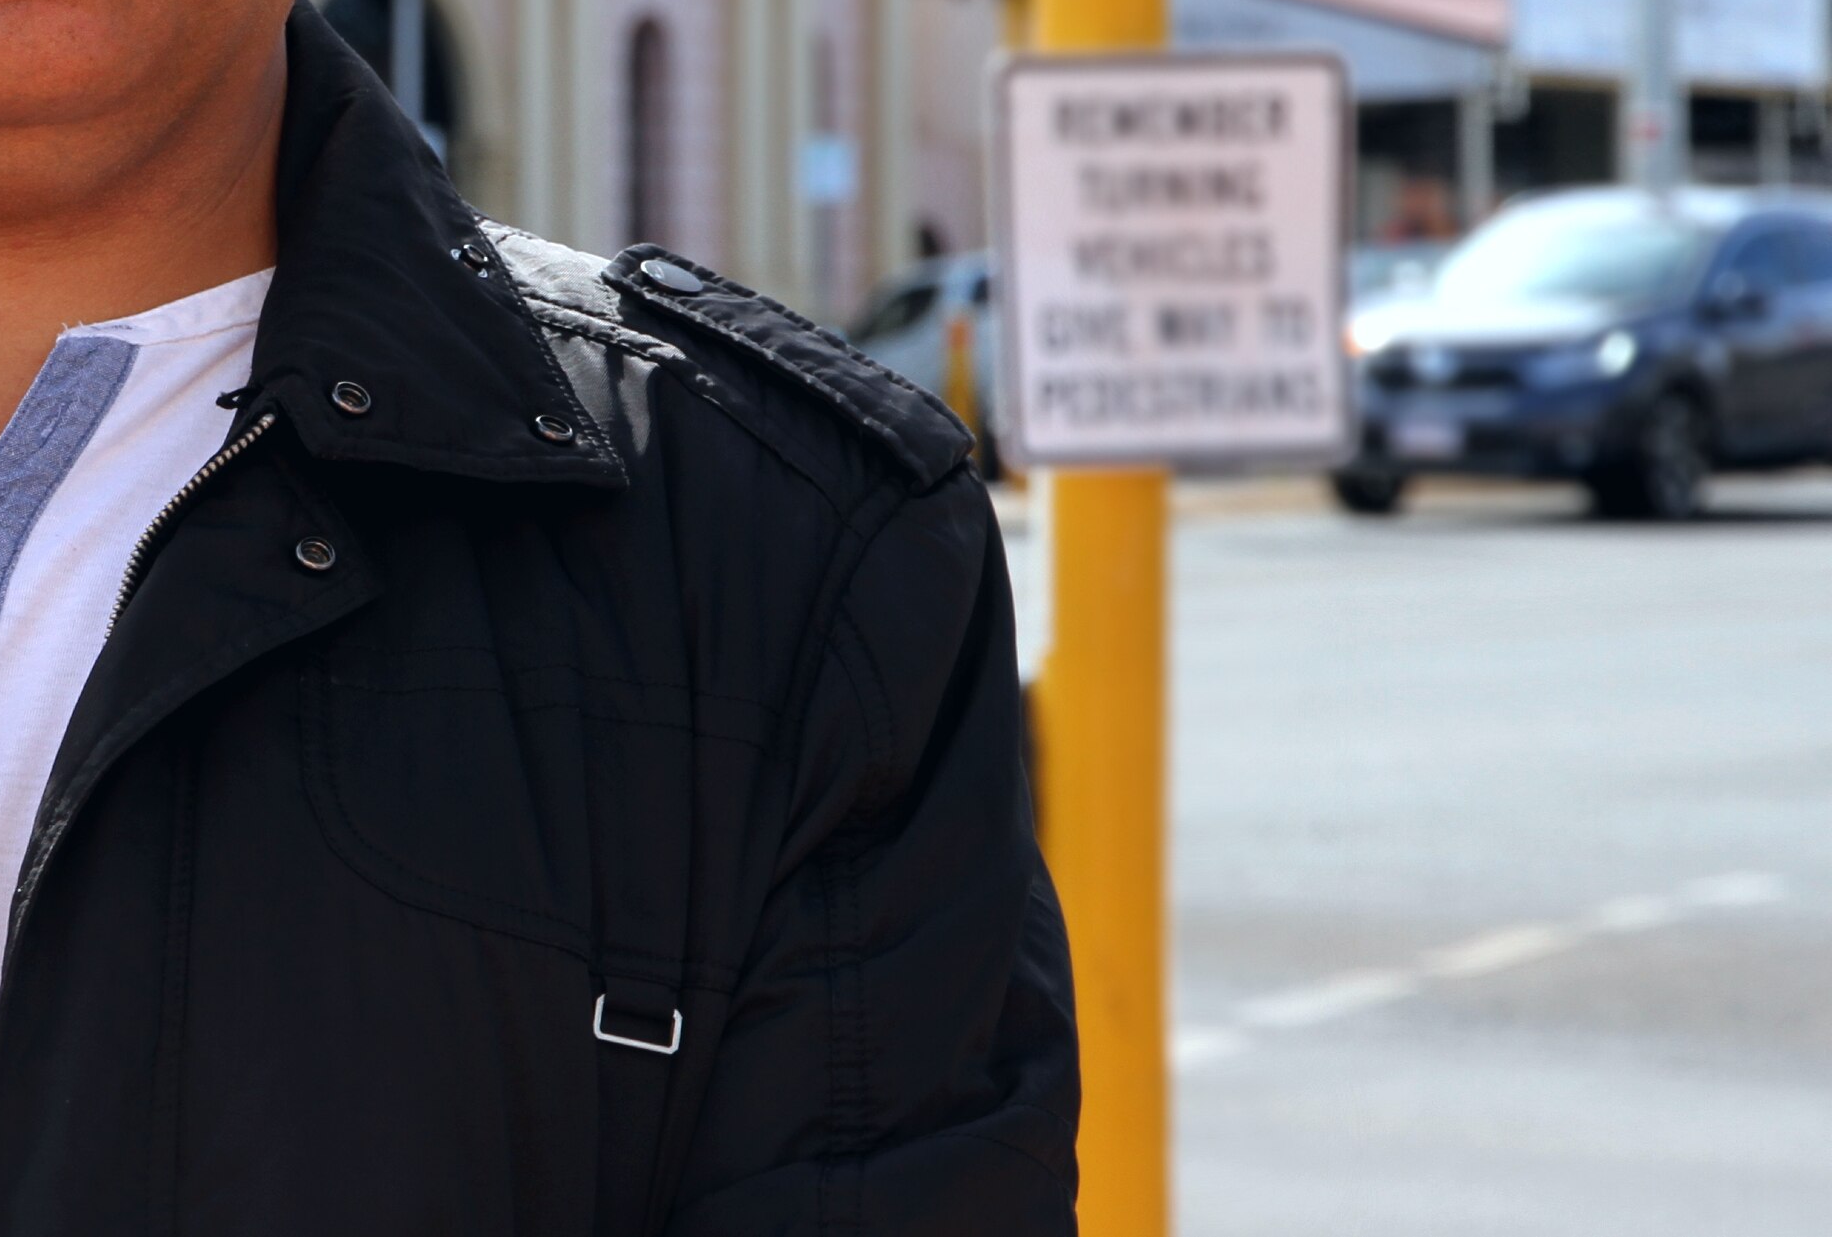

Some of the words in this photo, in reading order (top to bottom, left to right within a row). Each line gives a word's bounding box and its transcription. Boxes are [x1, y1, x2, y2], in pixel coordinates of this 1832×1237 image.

[1052, 92, 1289, 147] REMEMBER
[1078, 161, 1264, 215] TURNING
[1073, 229, 1275, 283] VEHICLES
[1038, 301, 1128, 354] GIVE
[1155, 300, 1236, 347] WAY
[1260, 295, 1314, 345] TO
[1035, 367, 1325, 427] PEDESTRIANS
